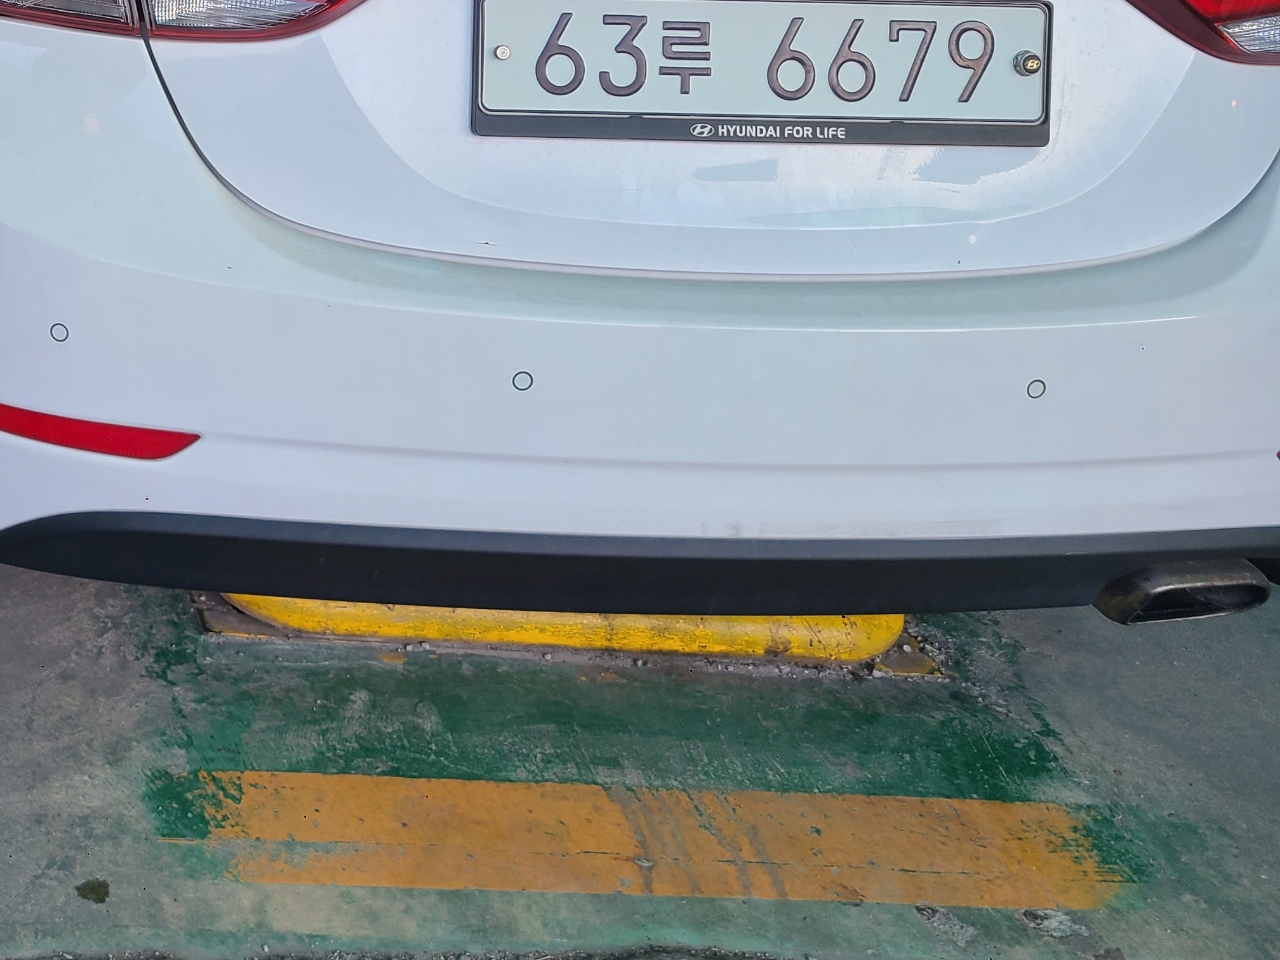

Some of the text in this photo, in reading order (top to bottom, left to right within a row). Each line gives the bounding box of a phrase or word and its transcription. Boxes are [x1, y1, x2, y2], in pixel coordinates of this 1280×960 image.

[534, 12, 997, 103] 63루 6679
[718, 124, 846, 139] HYUNDAI FOR LIFE
